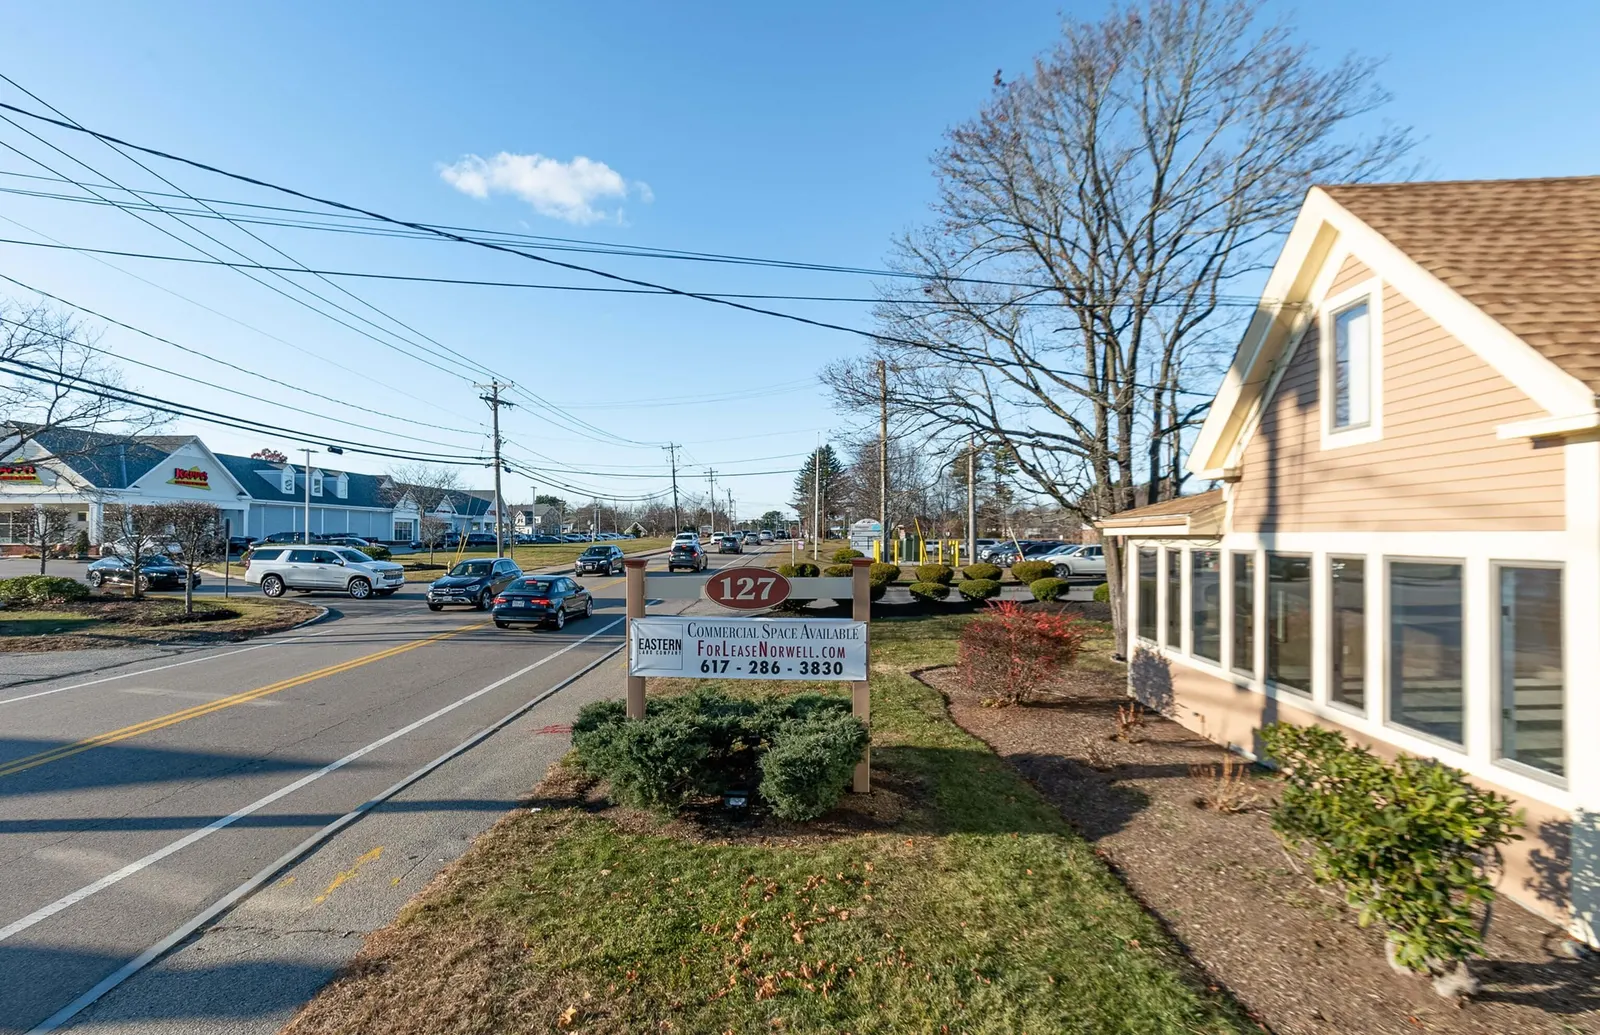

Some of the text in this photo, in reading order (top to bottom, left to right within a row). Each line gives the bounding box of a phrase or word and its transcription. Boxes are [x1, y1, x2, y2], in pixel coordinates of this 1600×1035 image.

[720, 577, 776, 600] 127
[687, 622, 859, 640] COMMERCIAL SPACE AVAILABLE
[639, 638, 682, 651] EASTERN
[700, 659, 730, 673] 617
[748, 660, 780, 675] 286
[799, 661, 843, 675] 3830
